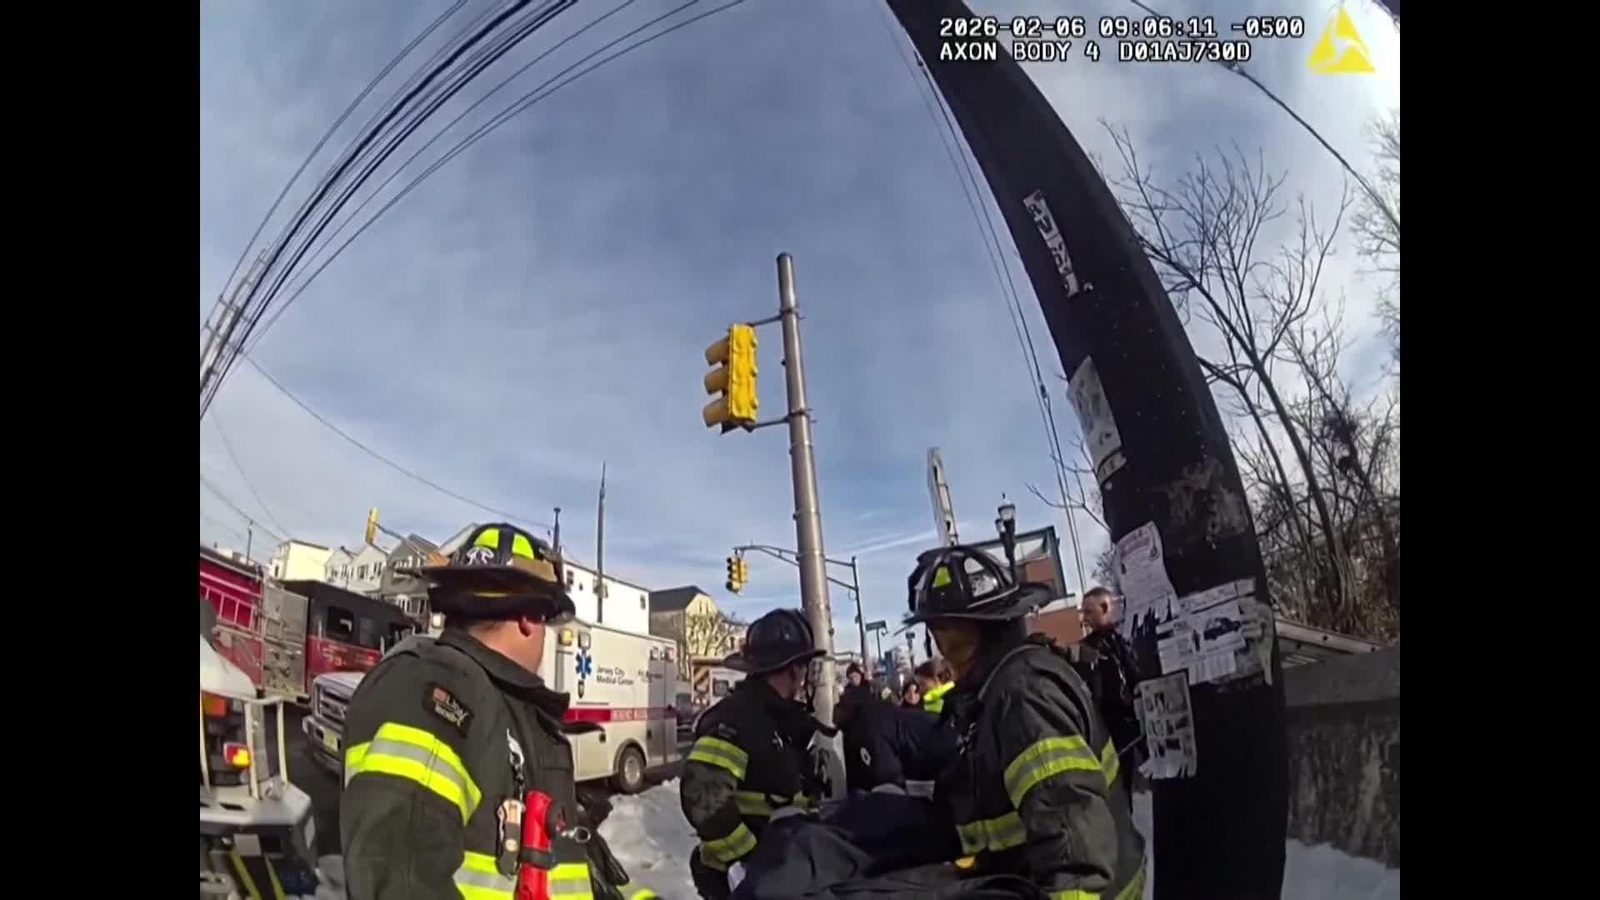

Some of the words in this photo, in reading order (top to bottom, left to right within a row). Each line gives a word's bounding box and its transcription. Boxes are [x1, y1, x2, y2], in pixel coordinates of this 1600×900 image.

[597, 666, 613, 676] Jersey
[614, 667, 625, 677] City
[596, 675, 616, 684] Medical
[617, 676, 634, 685] Center
